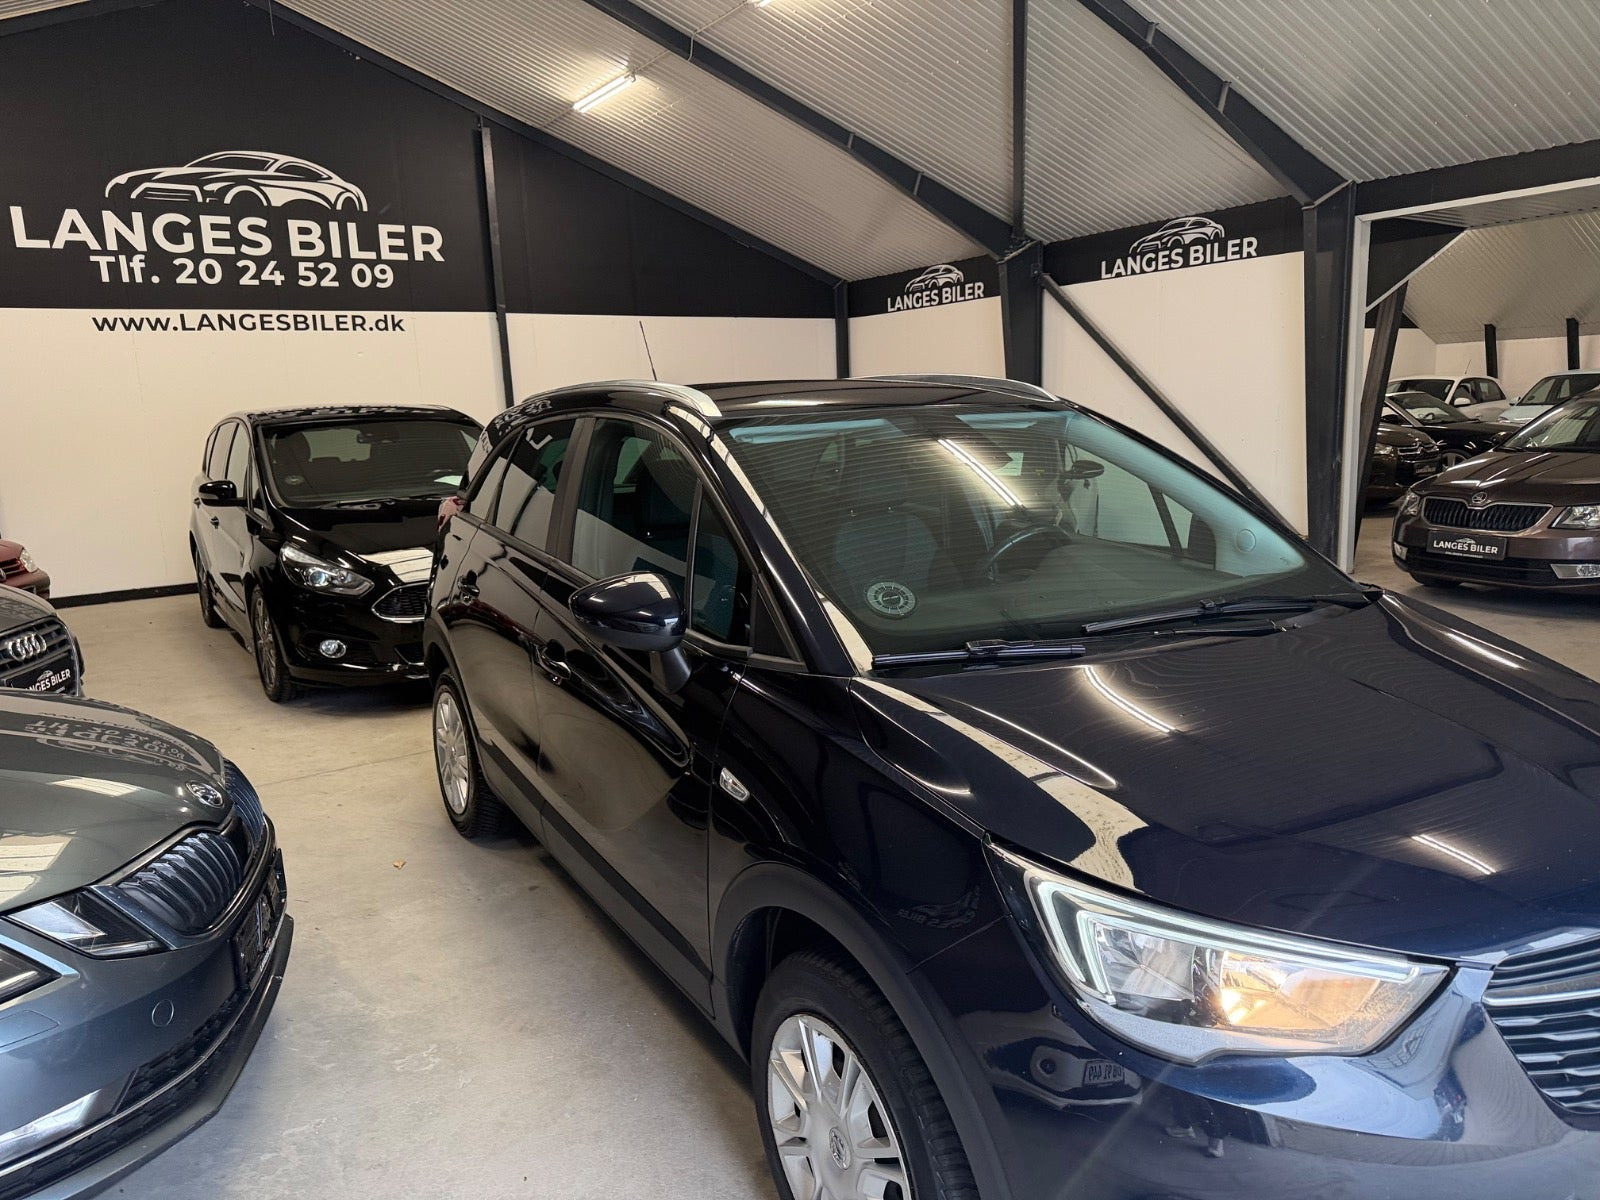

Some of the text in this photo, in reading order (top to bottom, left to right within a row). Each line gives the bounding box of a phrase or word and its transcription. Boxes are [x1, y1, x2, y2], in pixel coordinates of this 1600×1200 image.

[9, 205, 445, 262] LANGES BILER
[89, 254, 394, 288] Tlf. 20 24 52 09
[1100, 236, 1258, 279] LANGES BILER
[887, 281, 984, 312] LANGES BILER
[92, 313, 405, 333] www.LANGESBILER.dk
[1433, 540, 1498, 554] LANGES BILER
[50, 668, 71, 686] BILER
